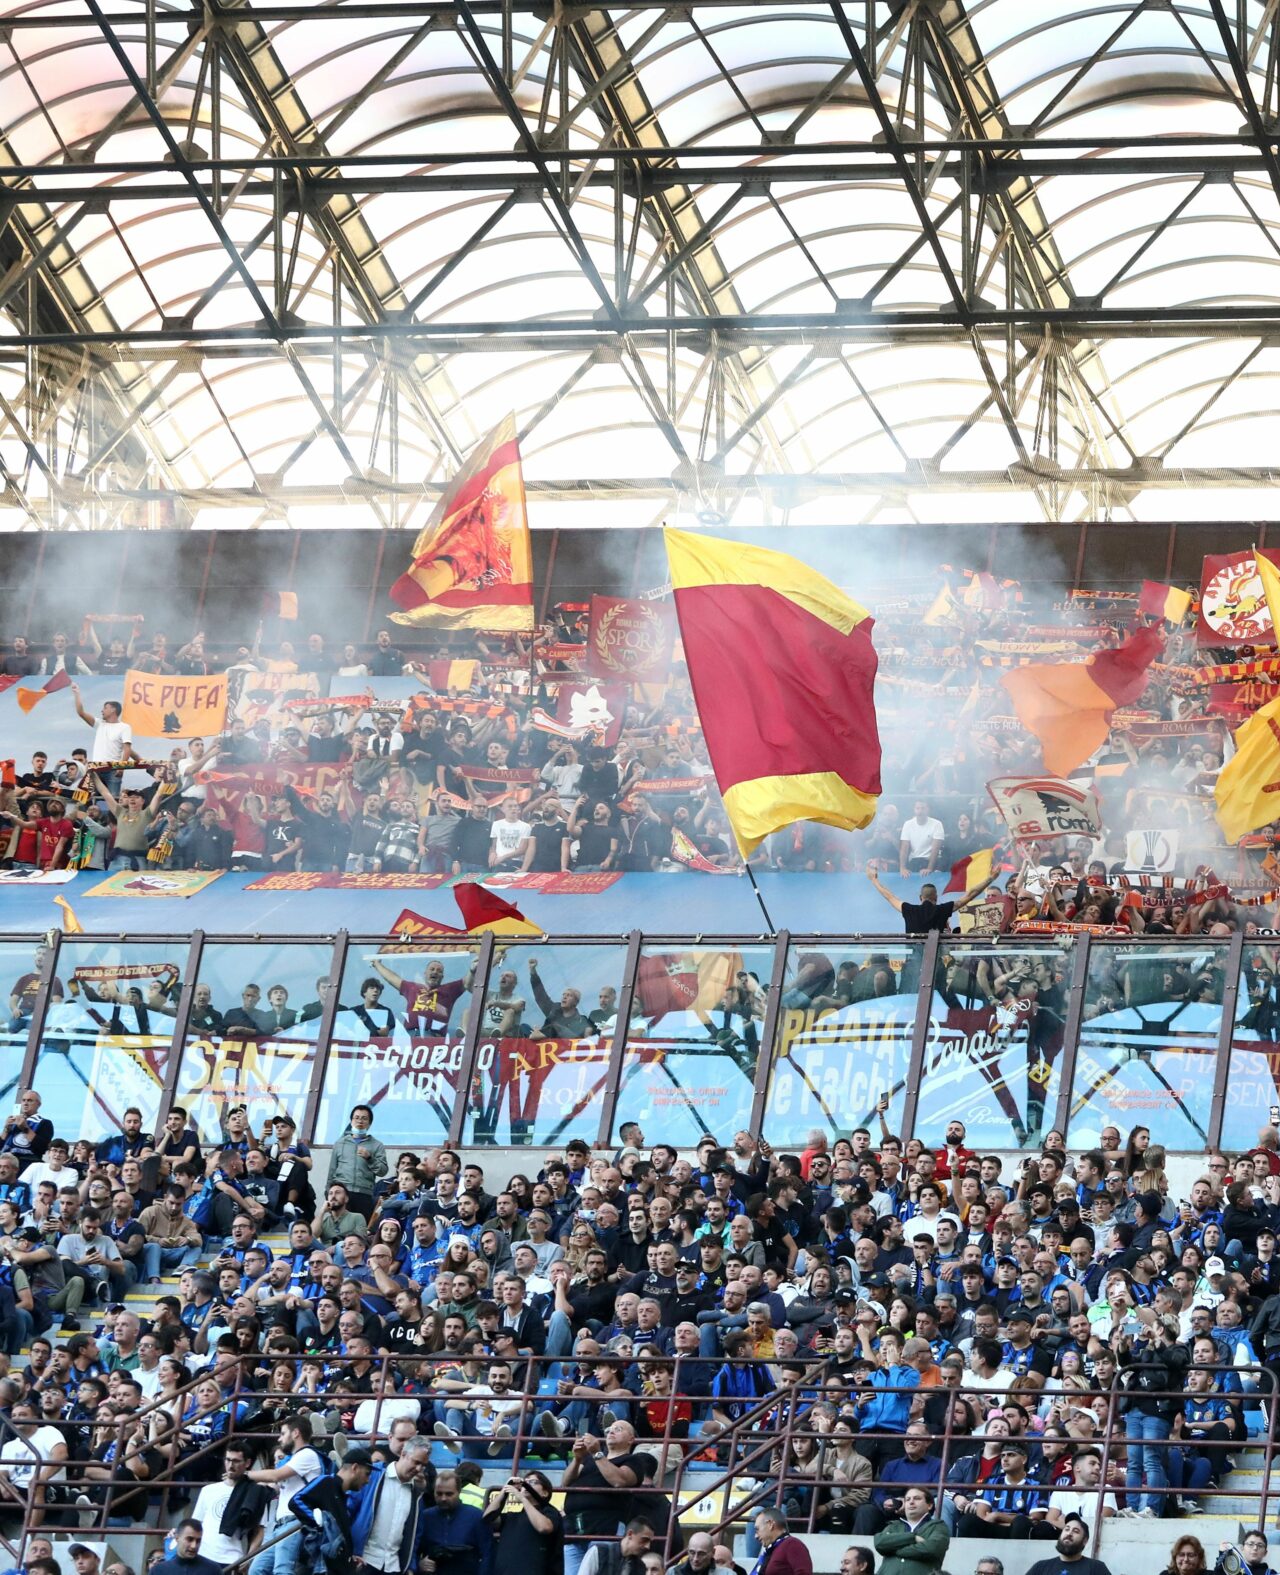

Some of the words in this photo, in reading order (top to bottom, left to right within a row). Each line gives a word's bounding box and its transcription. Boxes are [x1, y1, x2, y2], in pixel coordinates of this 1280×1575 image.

[606, 629, 654, 652] SPQR
[132, 682, 154, 705] SE
[1161, 723, 1196, 734] ROMA
[487, 767, 521, 779] ROMA
[1046, 815, 1097, 834] roma
